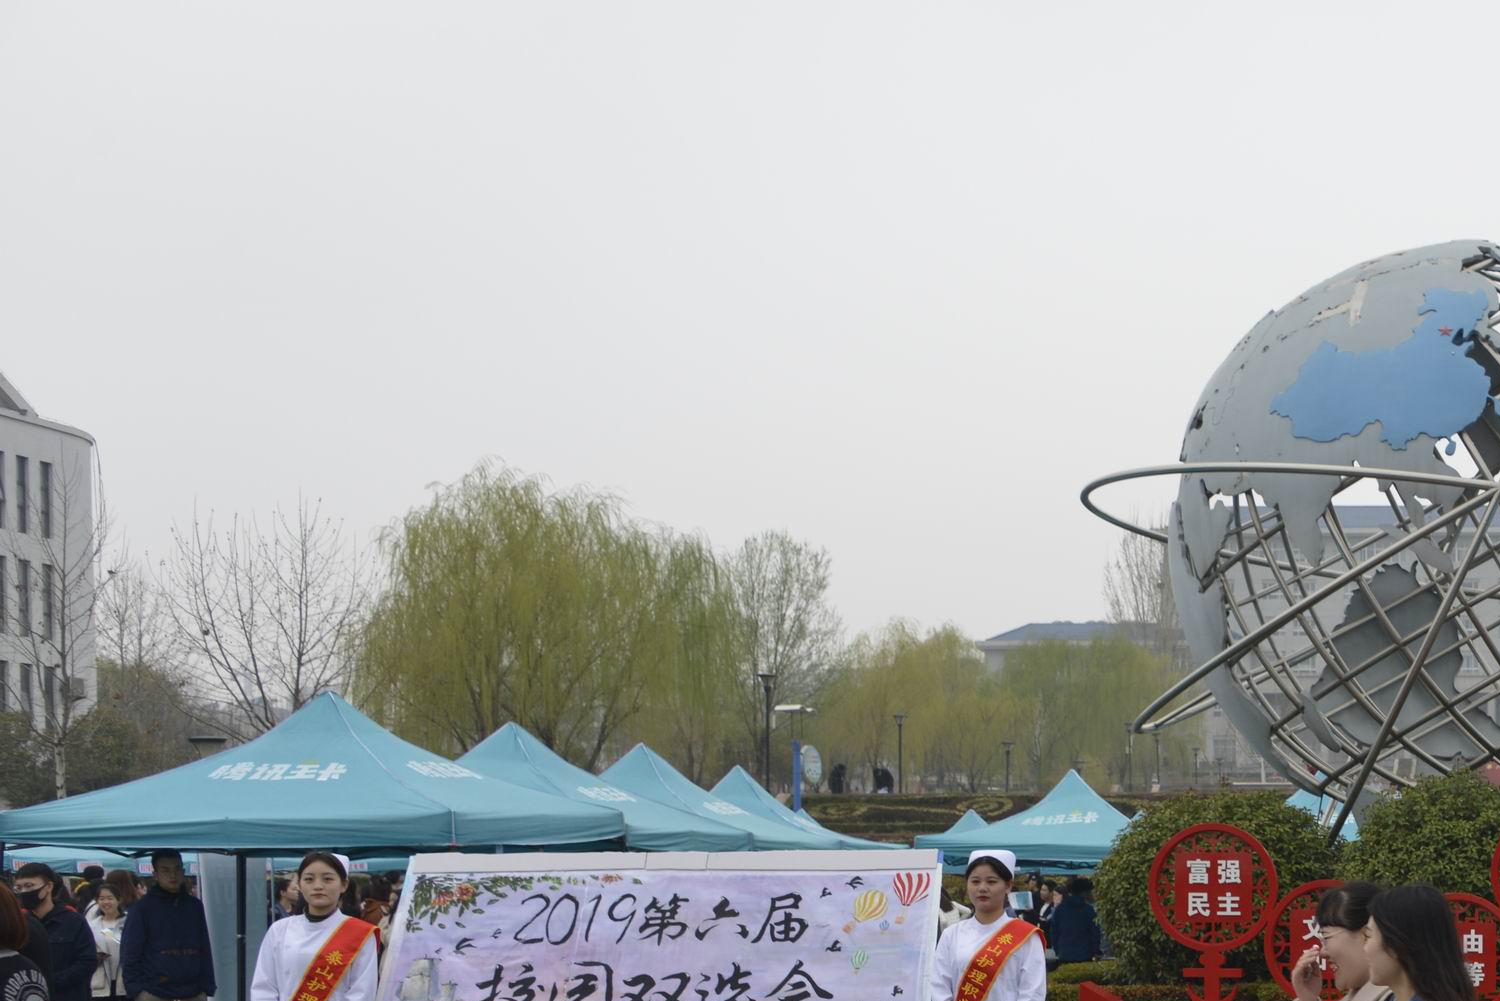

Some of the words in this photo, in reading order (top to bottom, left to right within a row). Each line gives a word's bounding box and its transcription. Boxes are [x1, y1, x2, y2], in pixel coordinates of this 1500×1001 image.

[208, 762, 347, 781] 腾讯王卡
[1187, 859, 1241, 884] 富强
[1188, 892, 1241, 917] 民主
[514, 893, 809, 946] 2019第六届
[1463, 929, 1483, 954] 由
